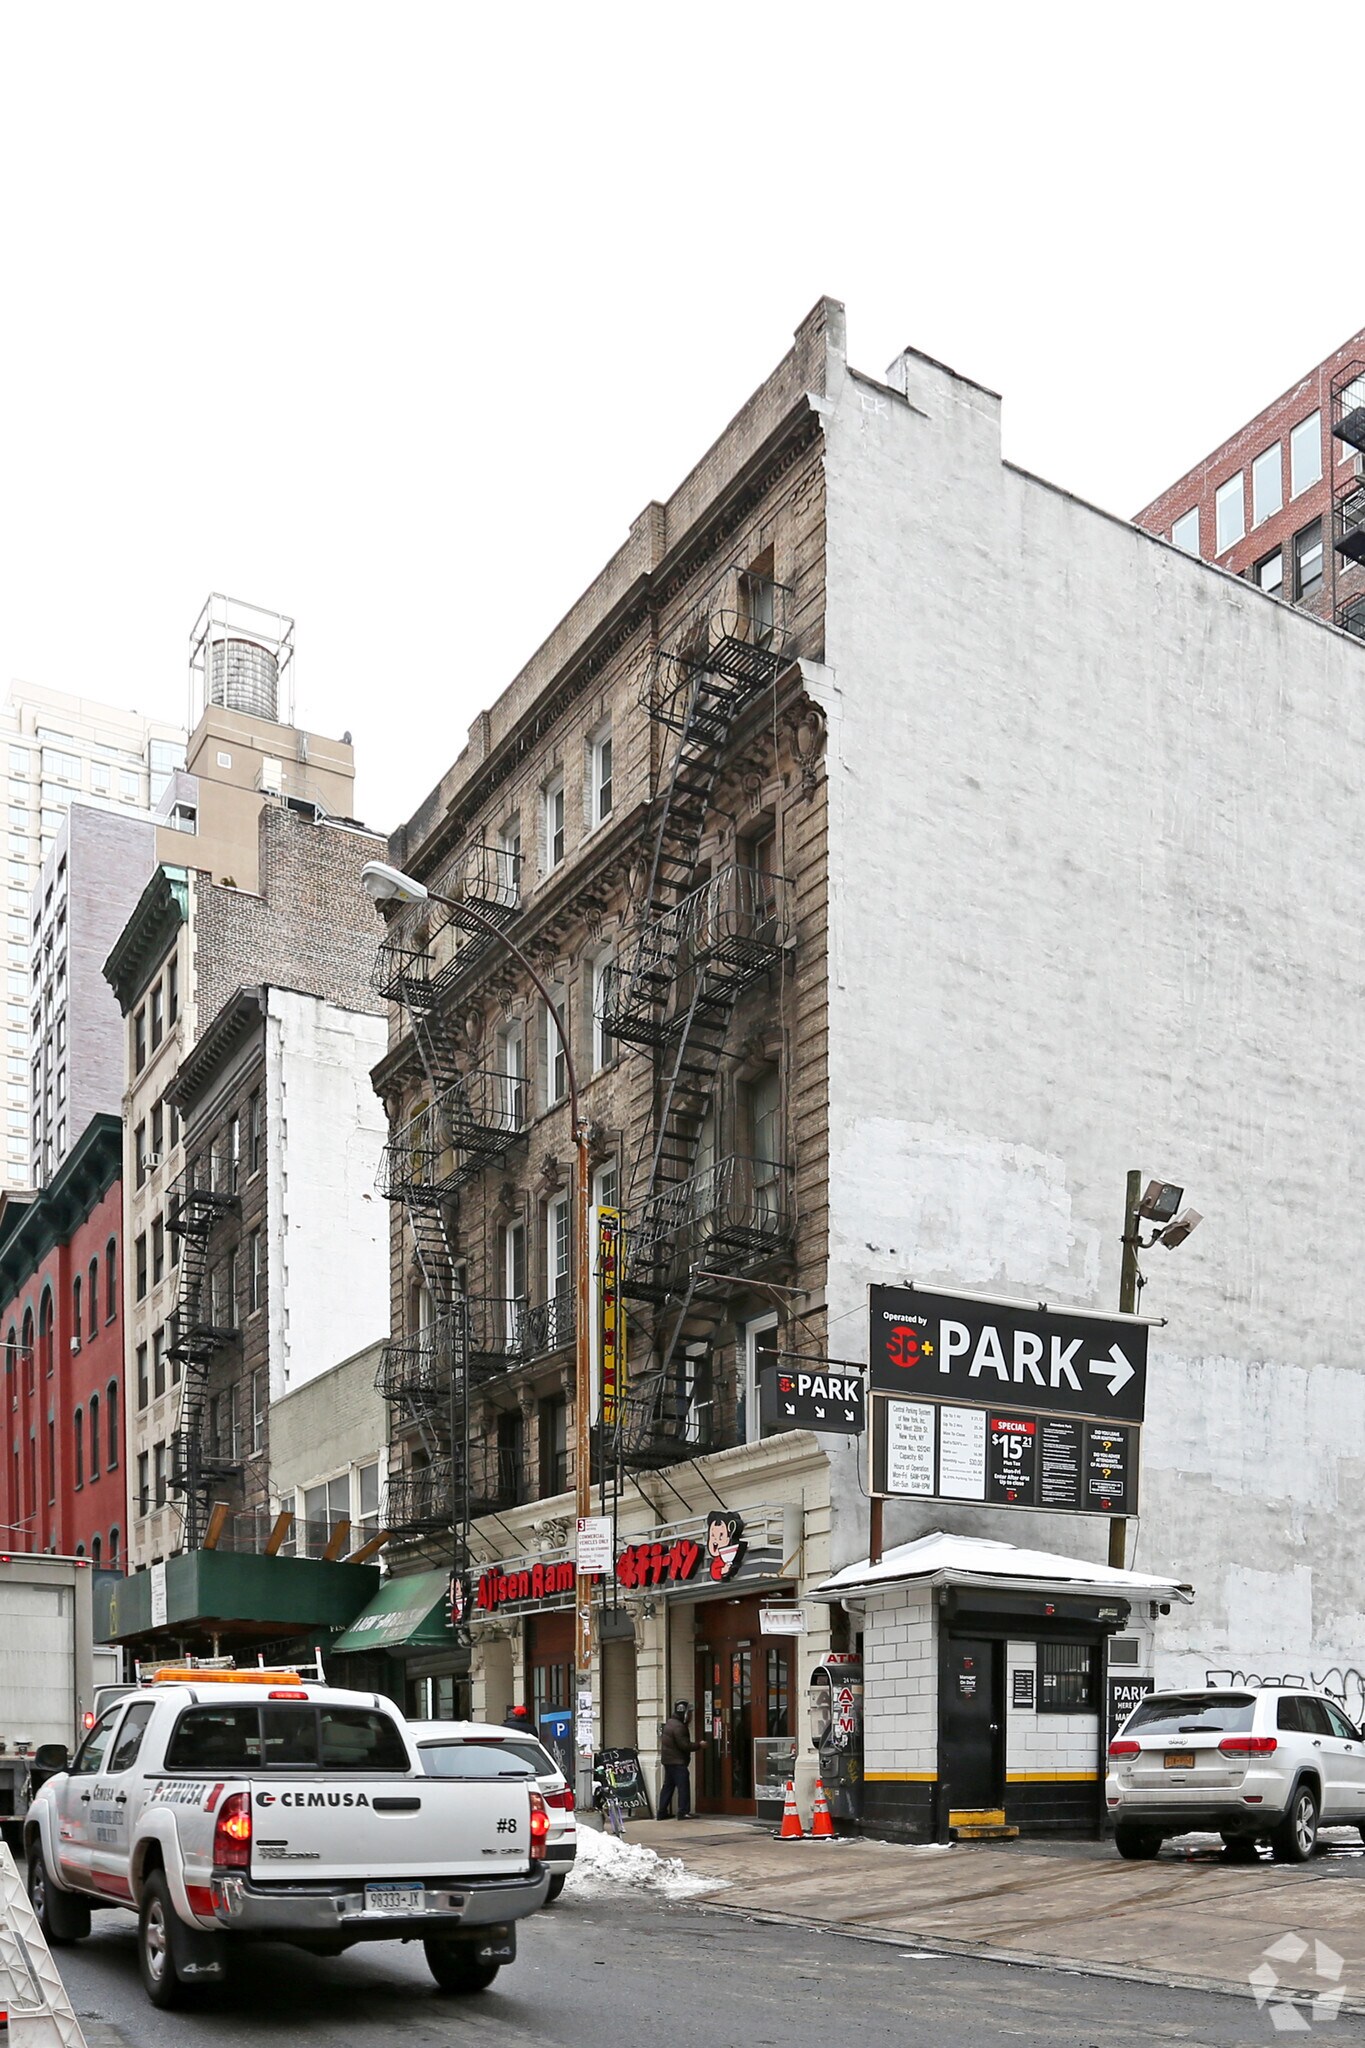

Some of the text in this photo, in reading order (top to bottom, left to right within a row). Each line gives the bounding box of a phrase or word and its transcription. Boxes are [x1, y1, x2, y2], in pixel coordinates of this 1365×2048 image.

[883, 1311, 928, 1326] Operated by
[939, 1319, 1084, 1392] PARK
[798, 1374, 859, 1402] PARK
[906, 1407, 918, 1415] Parking
[997, 1421, 1027, 1432] SPECIAL
[578, 1520, 584, 1531] 3
[477, 1568, 529, 1613] Ajisen
[827, 1654, 860, 1663] ATM
[1114, 1686, 1149, 1700] PARK
[838, 1688, 854, 1733] ATM
[556, 1723, 566, 1737] P
[161, 1782, 206, 1806] CEMUSA
[281, 1792, 370, 1807] CEMUSA
[496, 1818, 517, 1834] #8
[183, 1962, 221, 1974] 4x4
